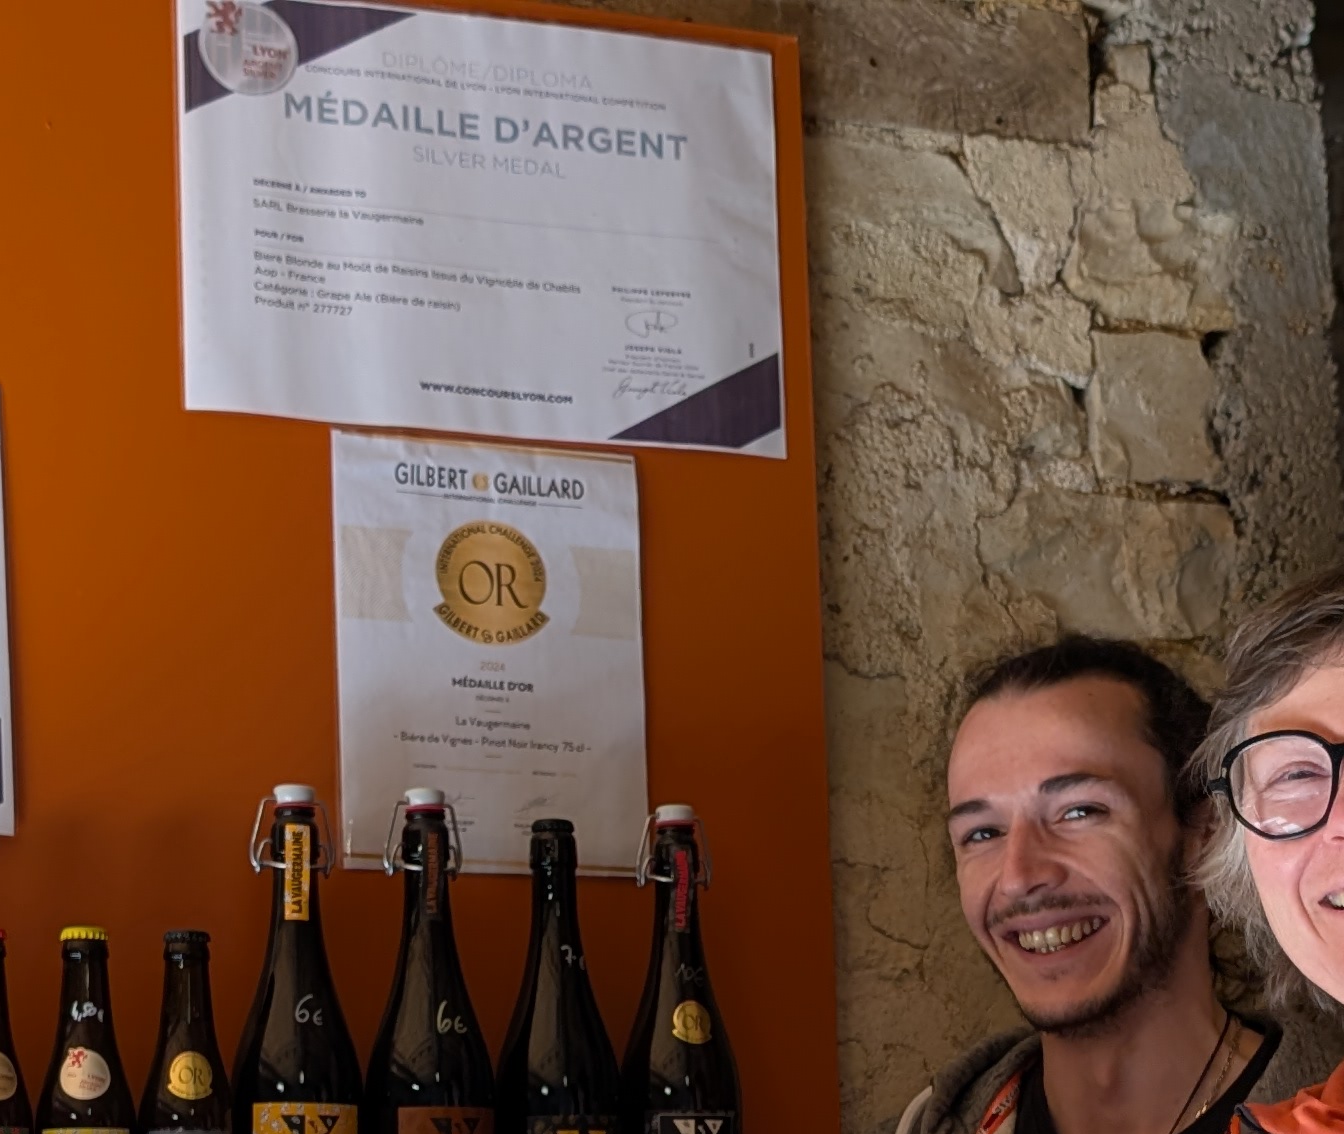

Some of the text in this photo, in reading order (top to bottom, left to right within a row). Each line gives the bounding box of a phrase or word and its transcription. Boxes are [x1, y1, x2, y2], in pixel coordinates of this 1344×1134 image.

[284, 91, 688, 161] MÉDAILLE D'ARGENT
[413, 145, 566, 179] SILVER MEDAL
[419, 380, 573, 405] WWW.CONCOURSLYON.COM
[394, 462, 468, 490] GILBERT
[494, 472, 585, 500] GAILLARD
[459, 560, 529, 609] OR
[439, 605, 545, 642] GILBERT GAILLARD
[452, 675, 534, 693] MÉDAILLE D'OR
[291, 829, 304, 896] VAUGERMAINE
[295, 993, 324, 1027] 6€
[437, 1000, 467, 1035] 6€
